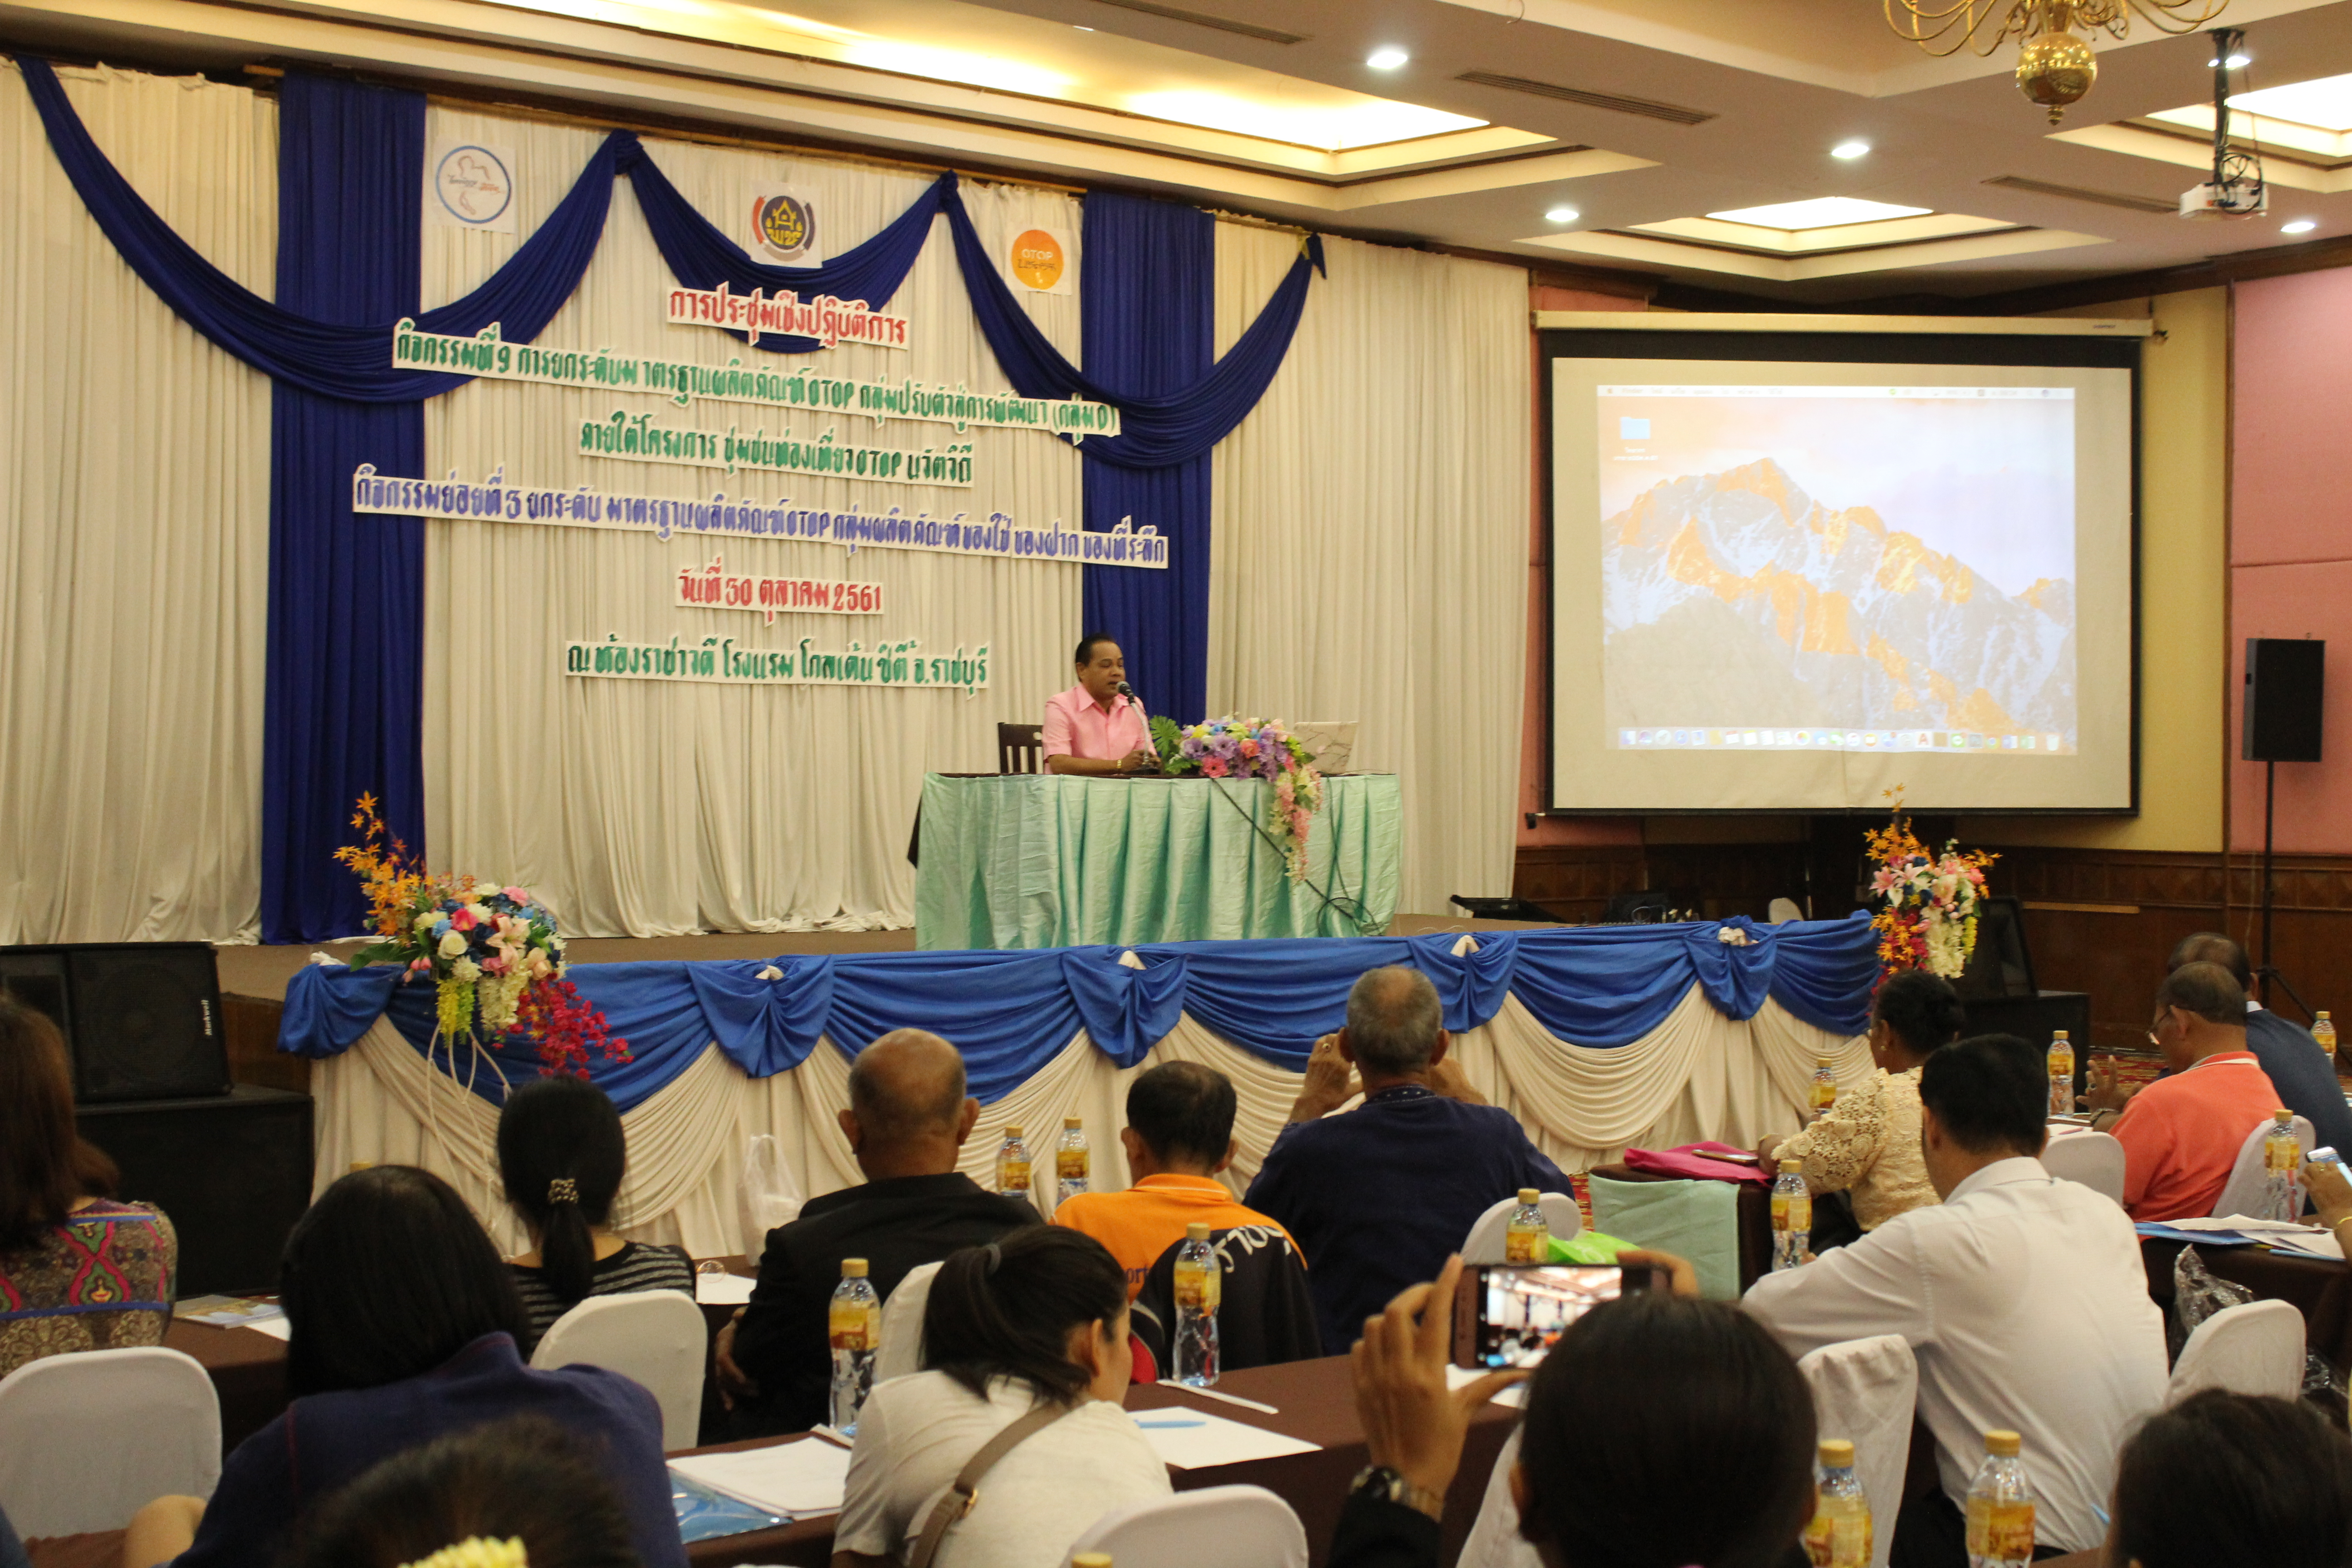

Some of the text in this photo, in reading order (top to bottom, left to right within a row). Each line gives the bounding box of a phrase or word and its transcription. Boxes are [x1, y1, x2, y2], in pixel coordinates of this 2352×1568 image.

[1022, 249, 1054, 260] OTOP
[670, 286, 906, 346] การประชุมเชิงปฏิบัติการ
[581, 411, 717, 459] ภายใต้โครงการ
[760, 579, 829, 622] ตุลาคม
[832, 583, 881, 611] 2561
[723, 639, 794, 679] โรงแรม
